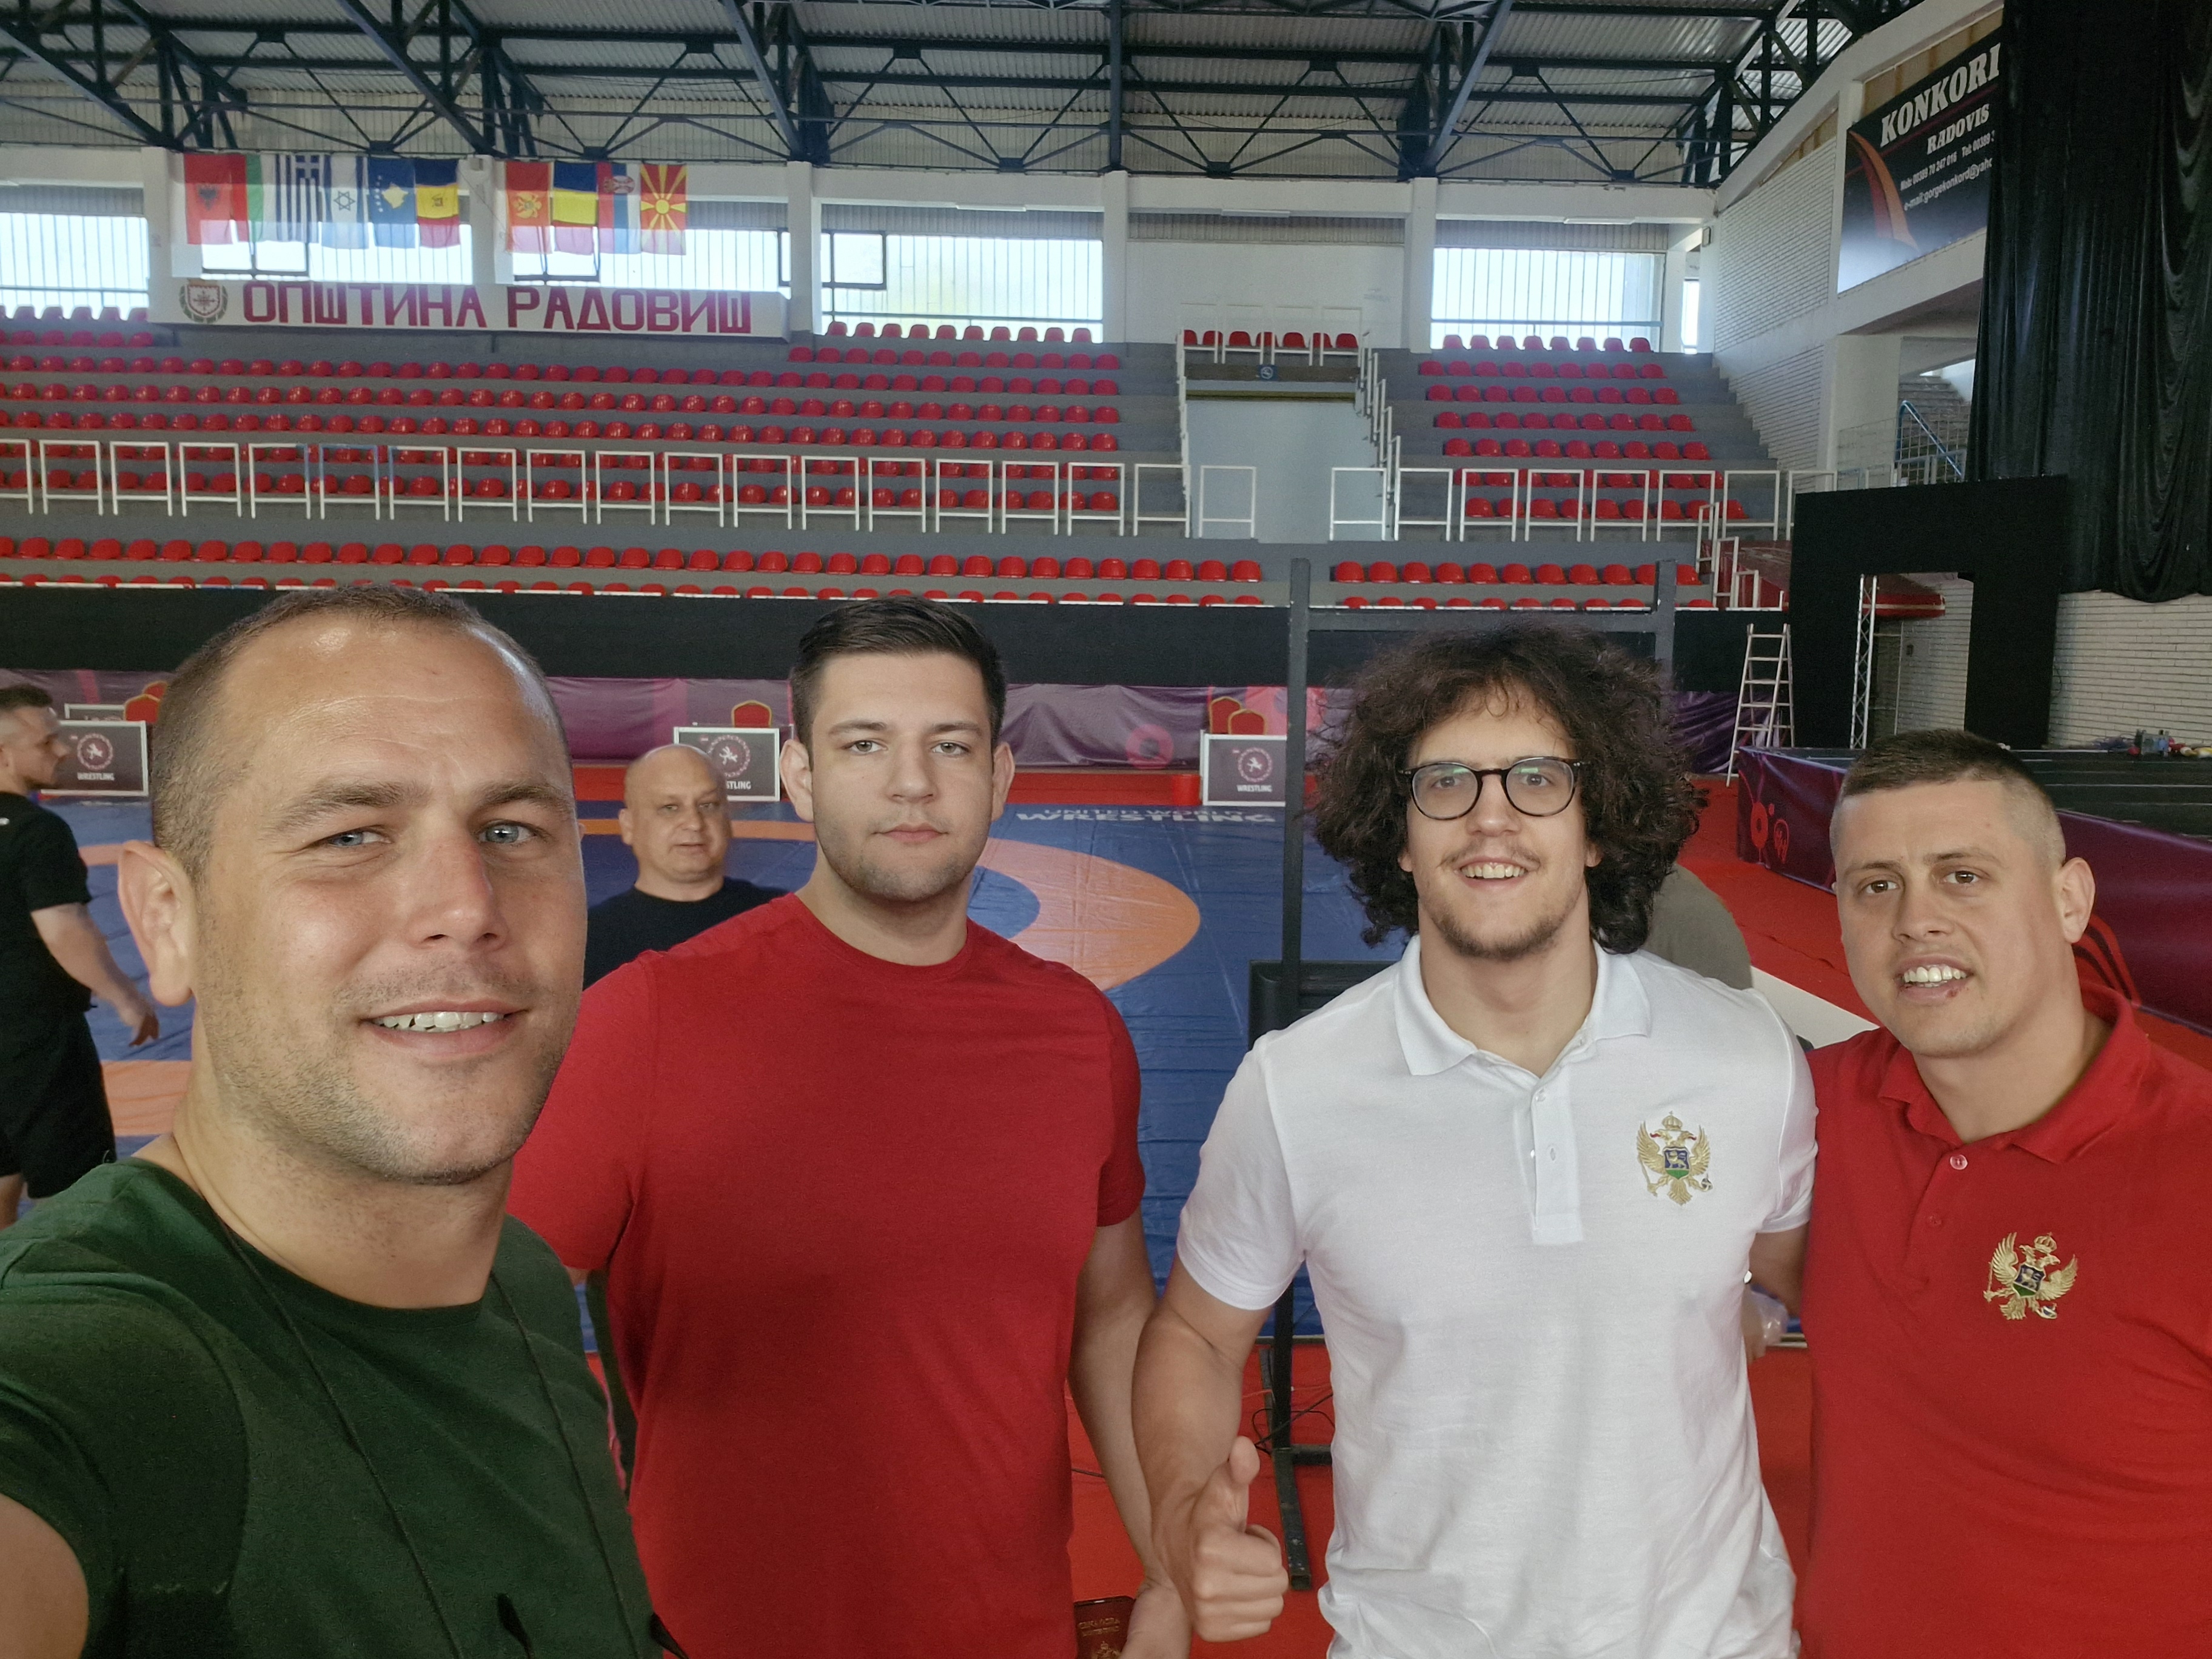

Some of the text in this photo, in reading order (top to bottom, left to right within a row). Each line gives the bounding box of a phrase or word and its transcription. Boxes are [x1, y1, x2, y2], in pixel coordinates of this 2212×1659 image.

[1927, 104, 1989, 155] RADOVIS
[243, 281, 752, 334] ОПШТИНА РАДОВИШ
[726, 781, 751, 789] STLING
